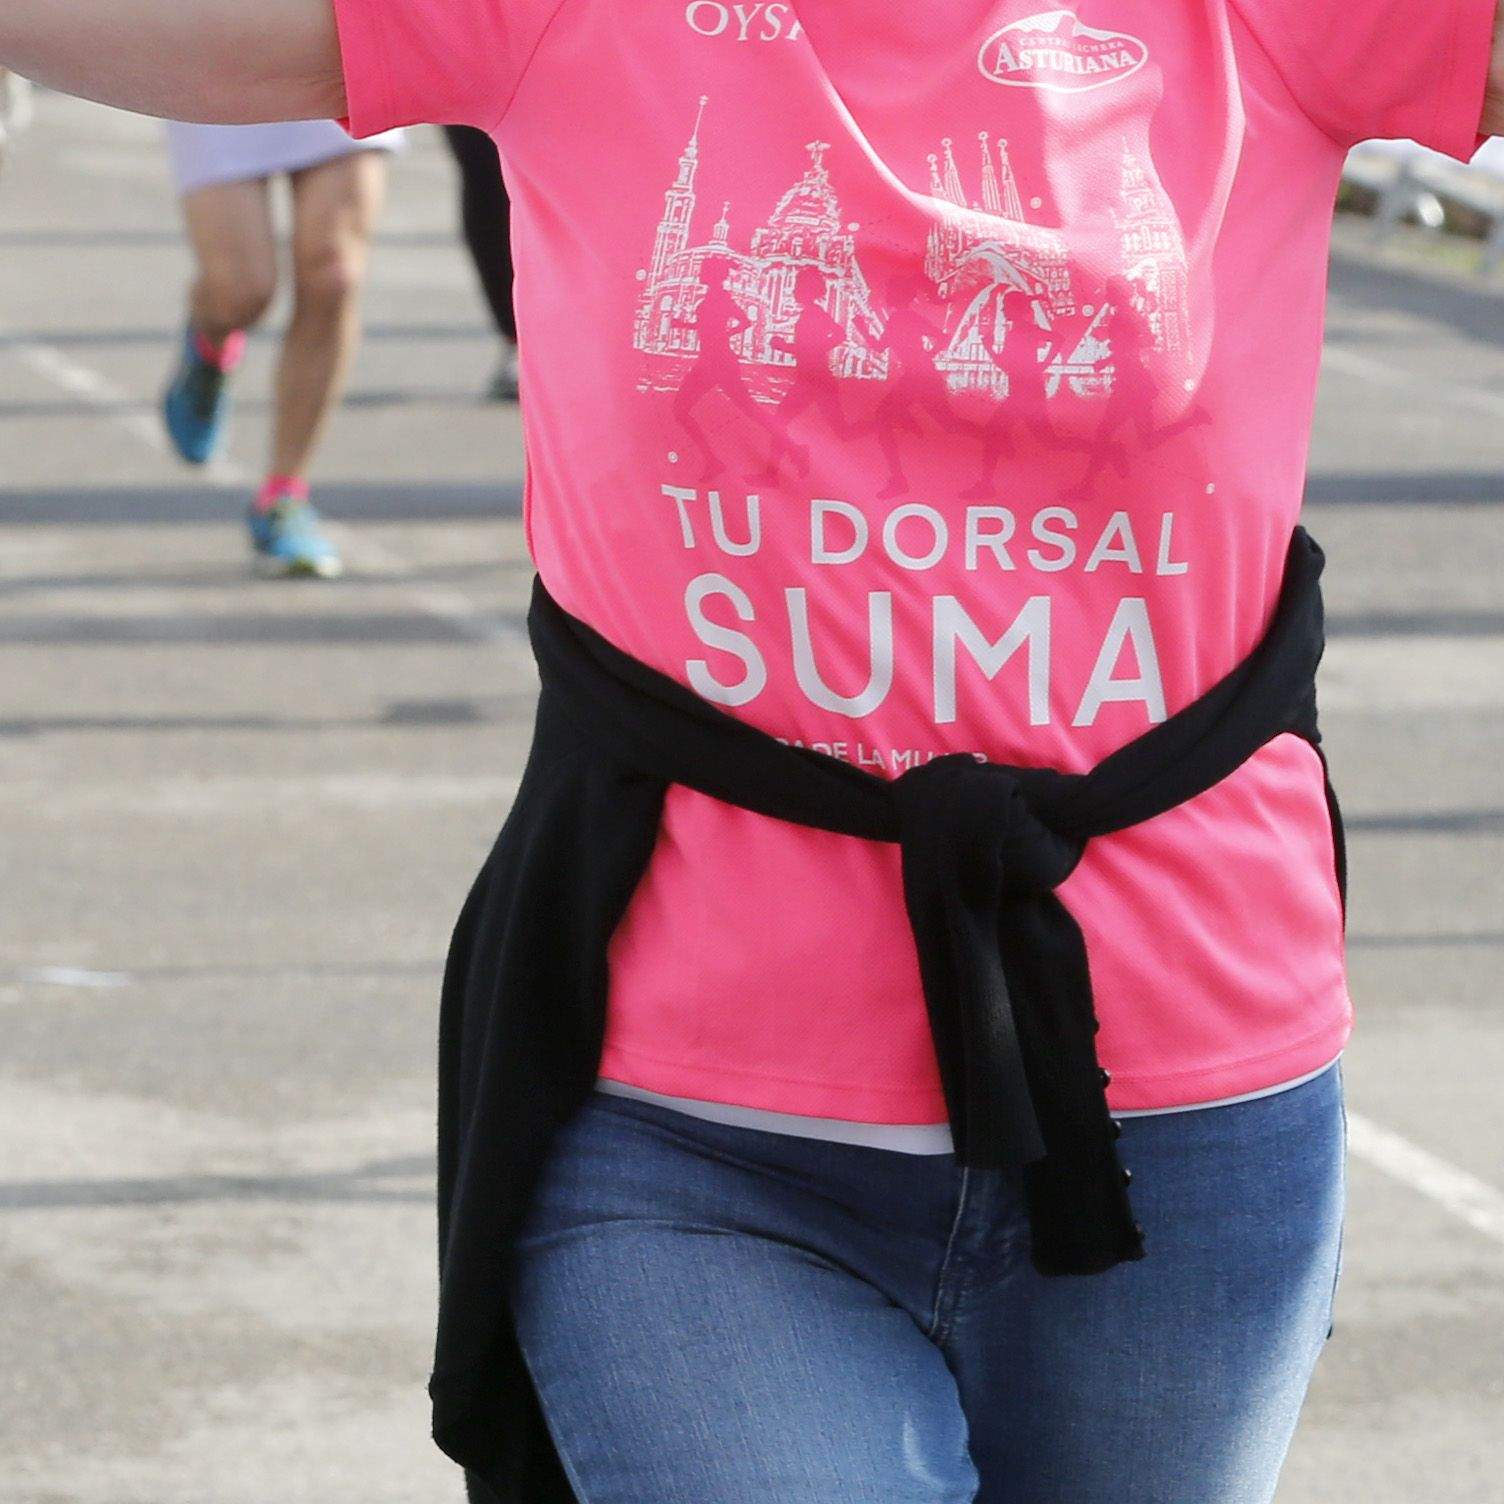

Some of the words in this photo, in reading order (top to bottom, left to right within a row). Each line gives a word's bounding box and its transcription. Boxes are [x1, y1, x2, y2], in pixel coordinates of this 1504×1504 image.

[993, 42, 1138, 75] ASTURIANA
[661, 483, 762, 557] TU
[809, 498, 1190, 576] DORSAL
[683, 572, 1168, 728] SUMA
[857, 742, 887, 770] LA
